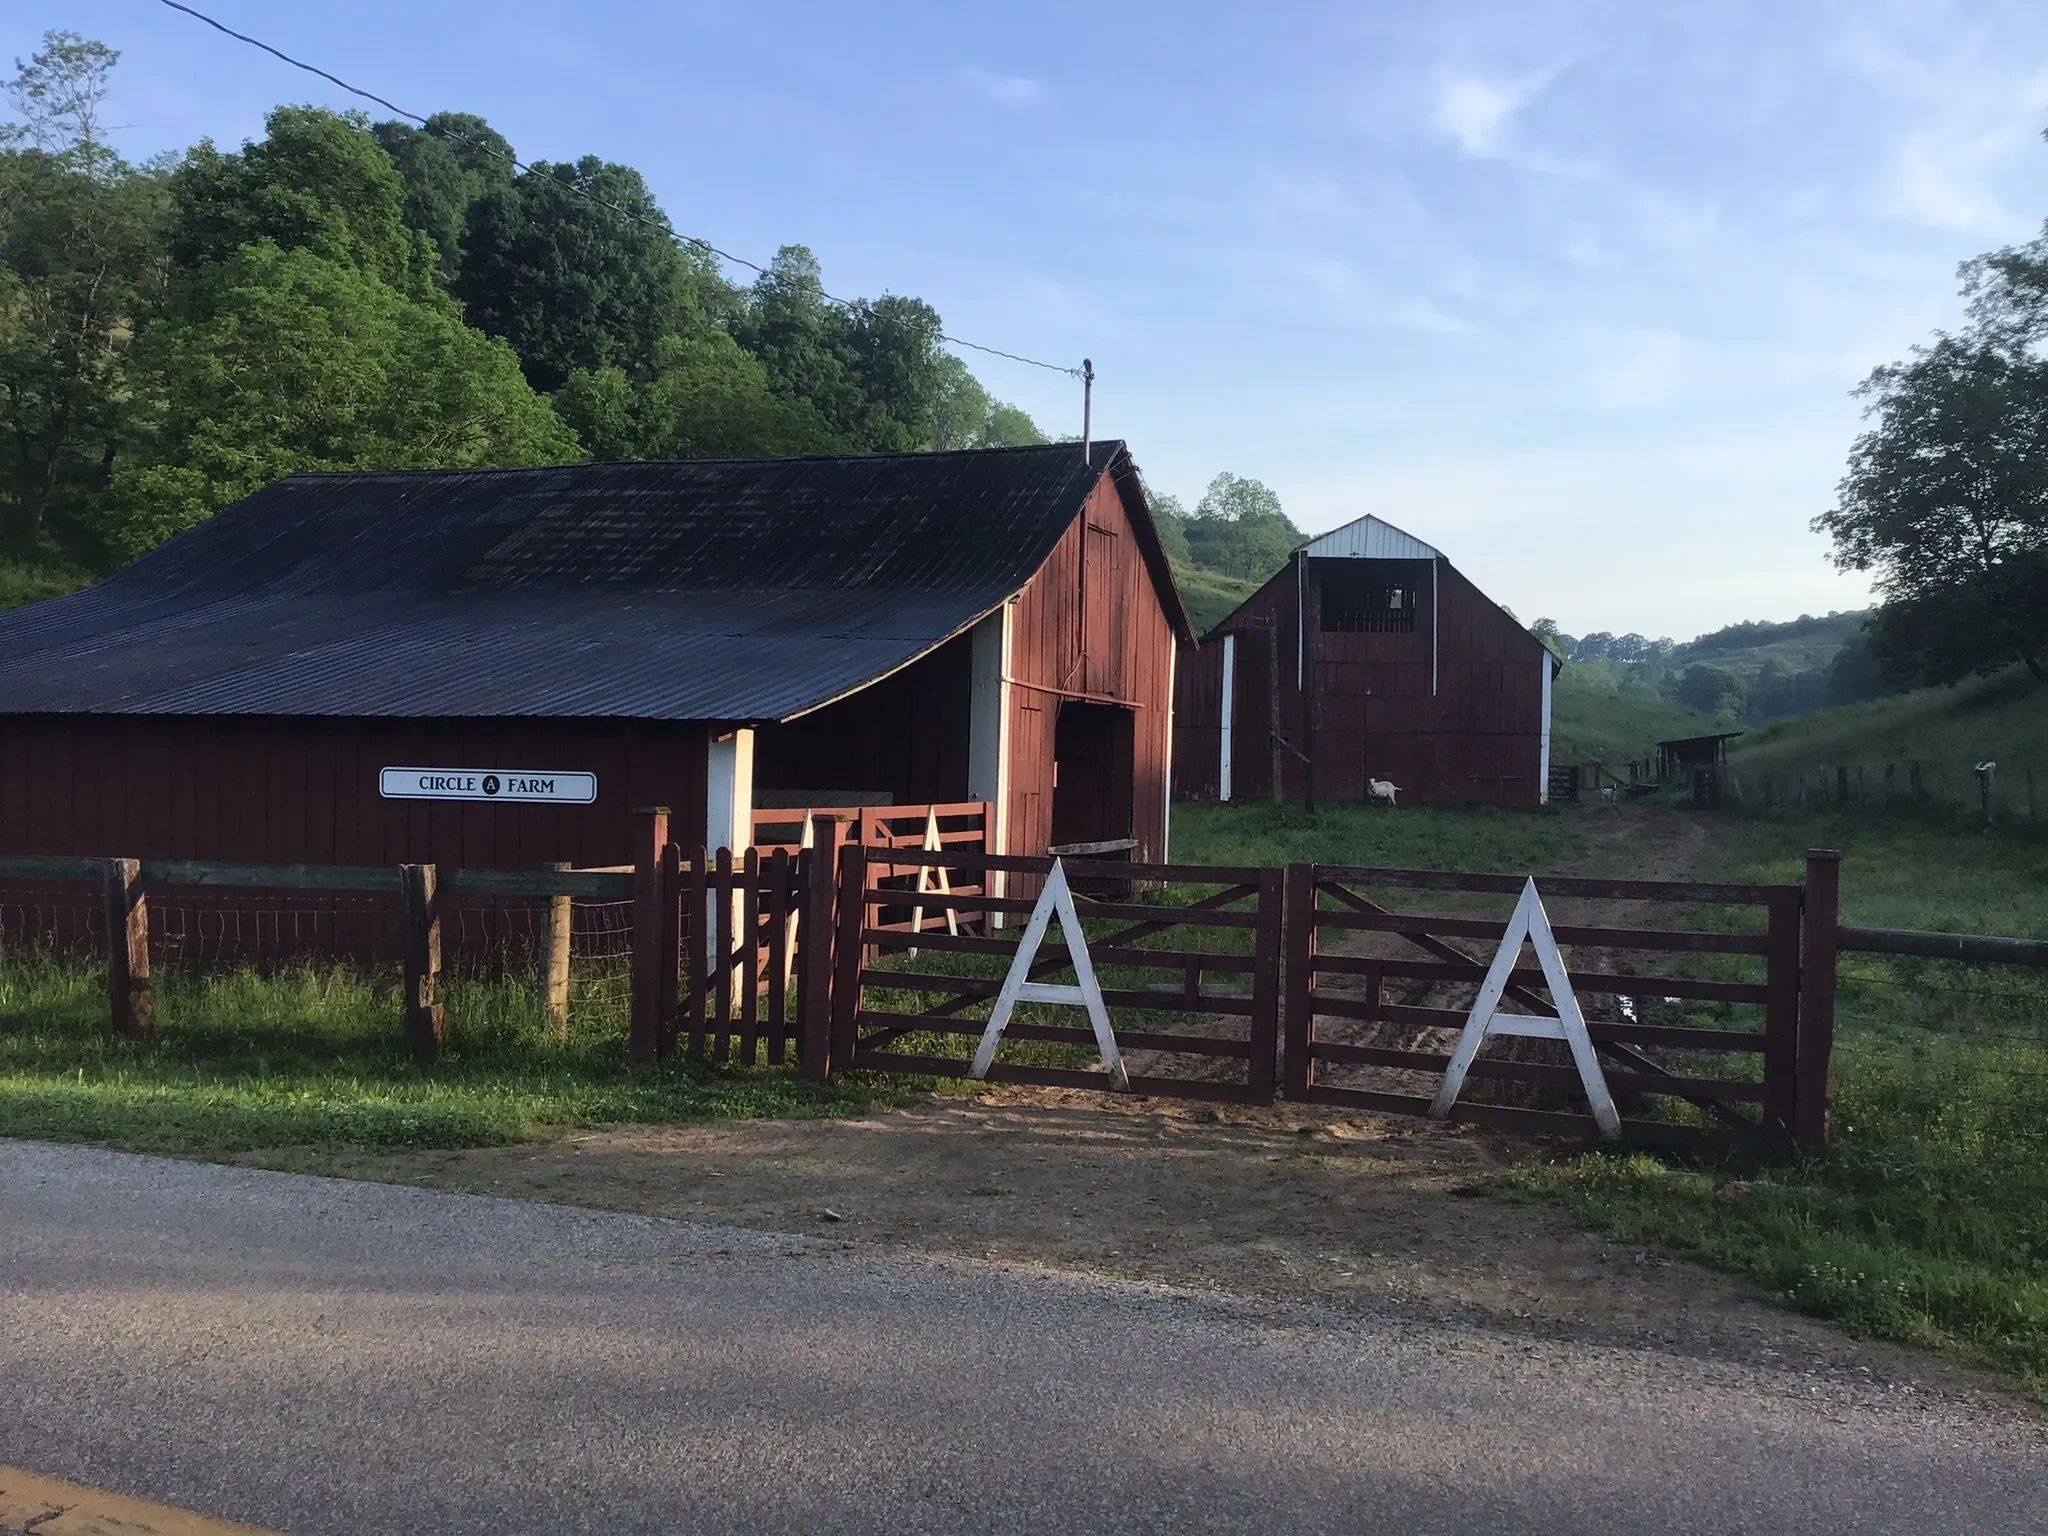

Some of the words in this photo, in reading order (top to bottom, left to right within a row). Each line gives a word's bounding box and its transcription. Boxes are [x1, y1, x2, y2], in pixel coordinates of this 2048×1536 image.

[419, 776, 476, 791] CIRCLE
[507, 778, 555, 793] FARM
[966, 856, 1131, 1093] A
[1427, 874, 1622, 1140] A
